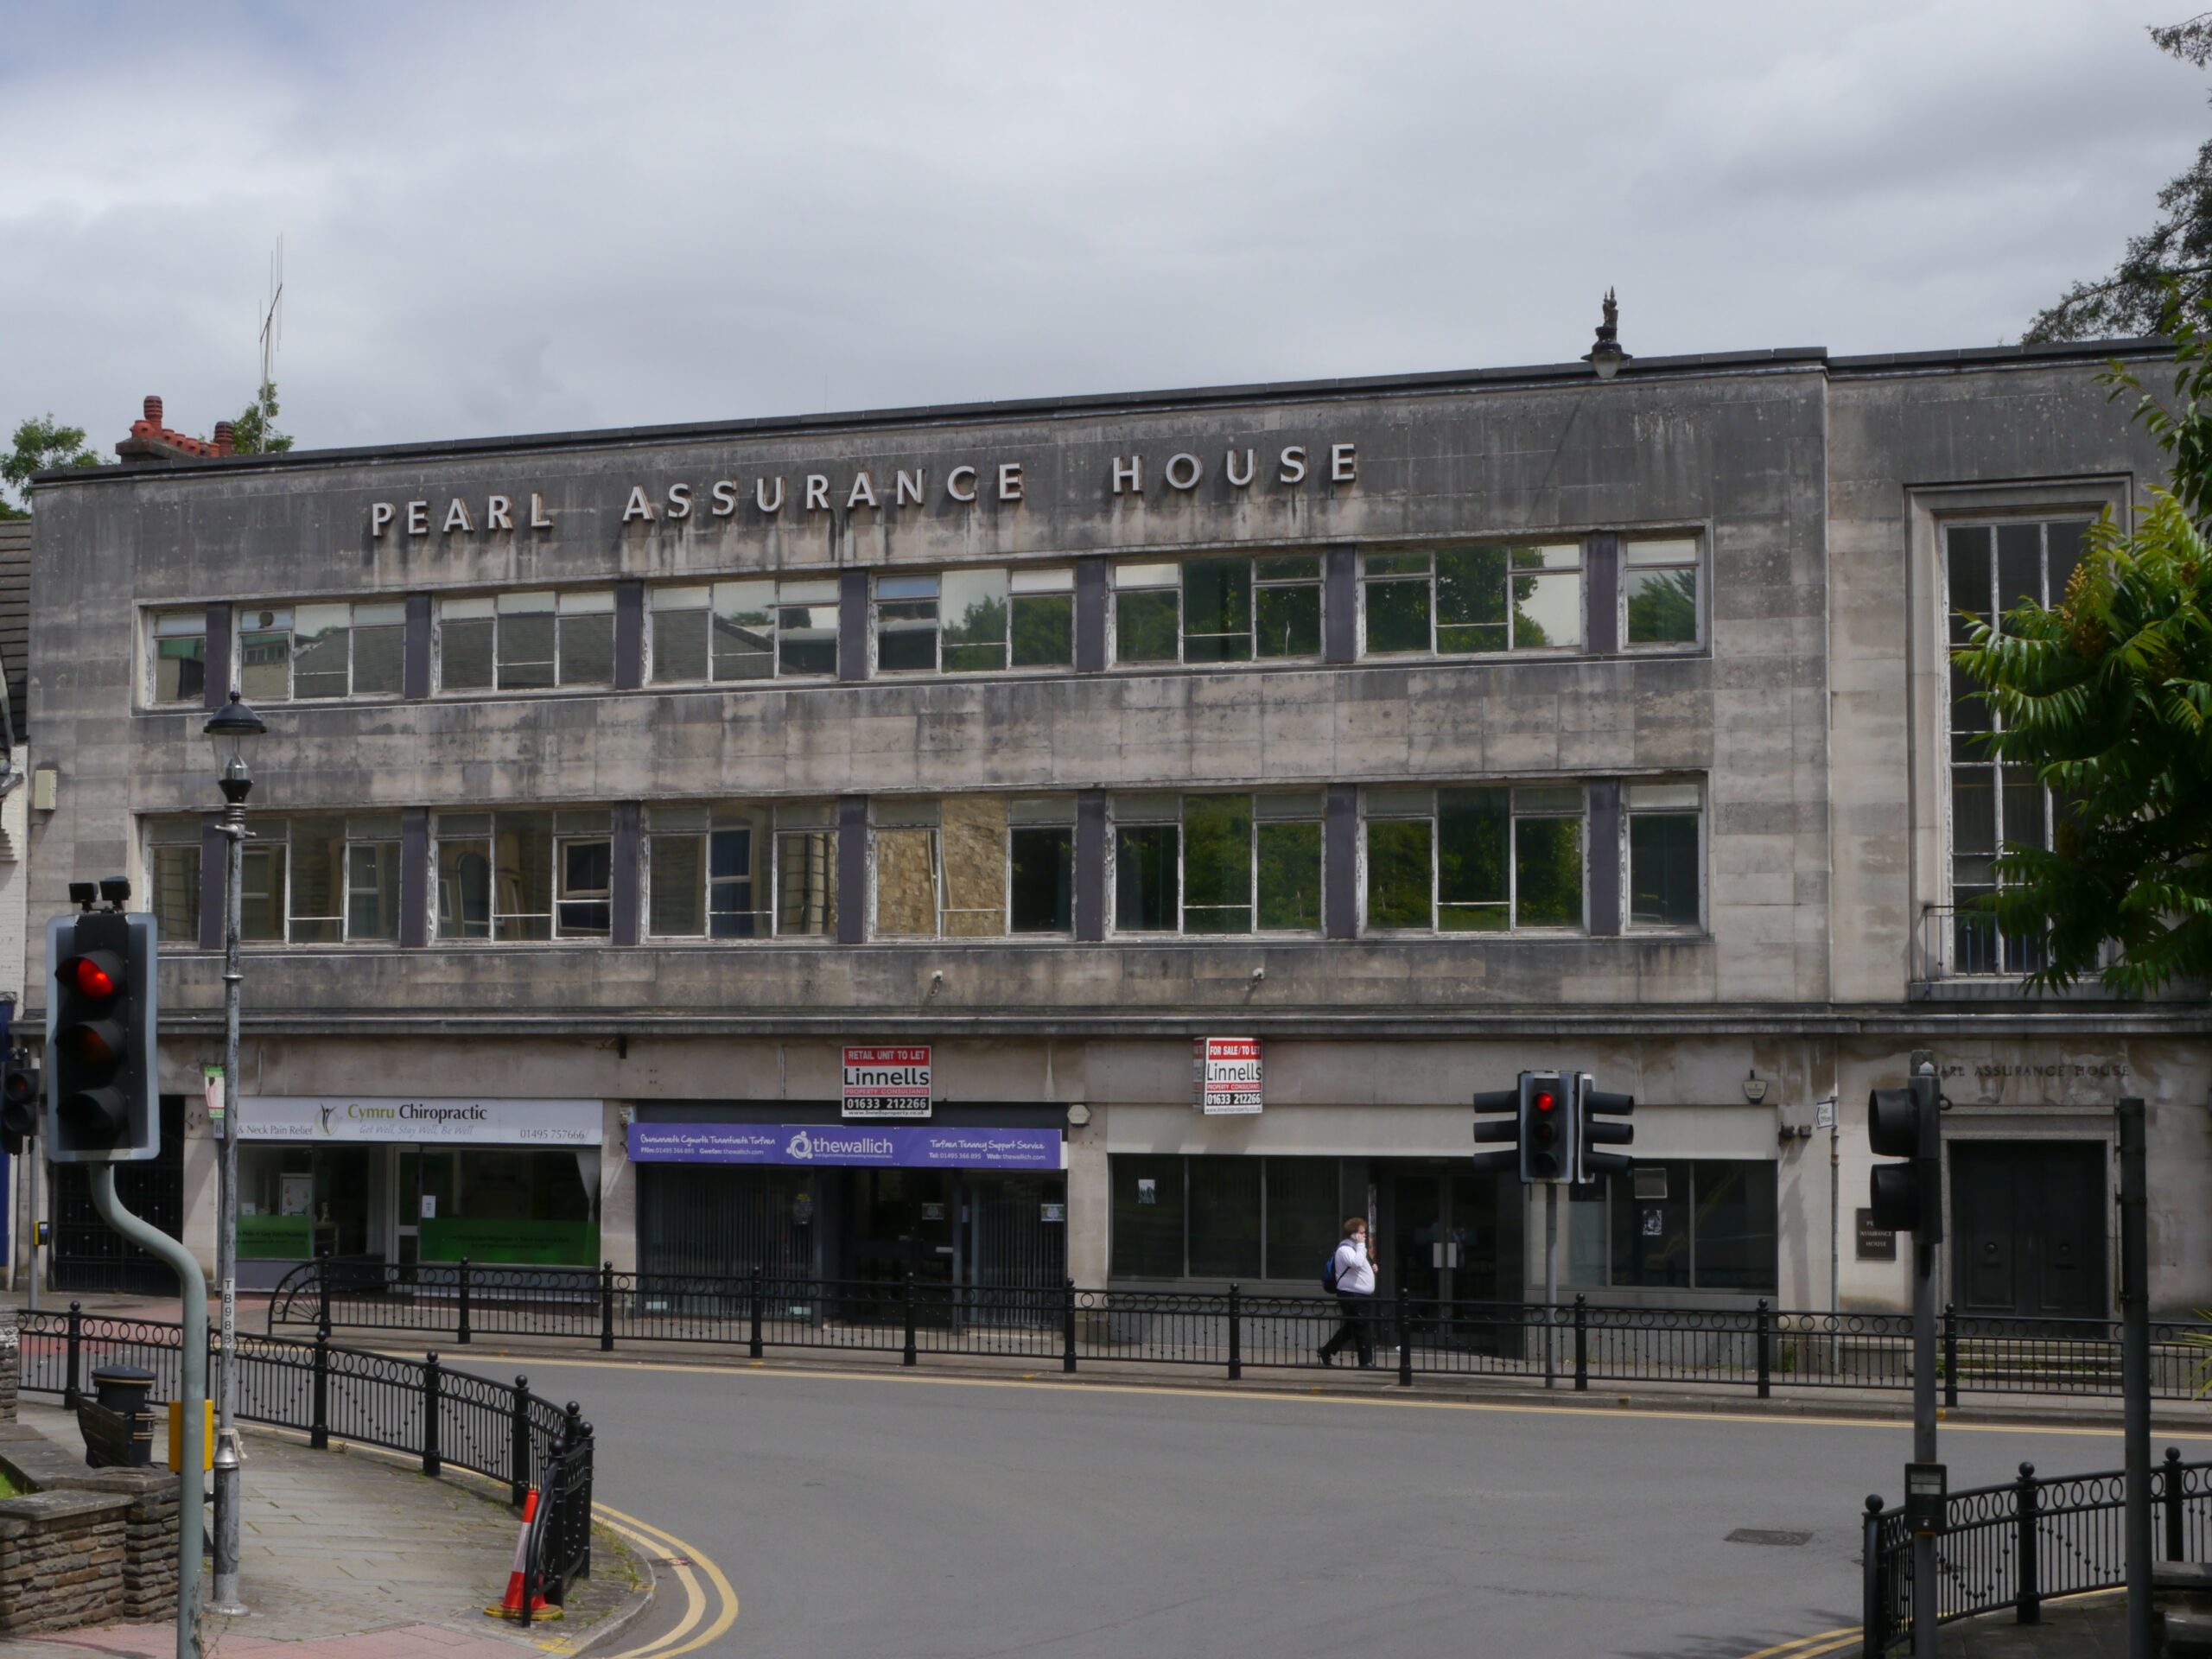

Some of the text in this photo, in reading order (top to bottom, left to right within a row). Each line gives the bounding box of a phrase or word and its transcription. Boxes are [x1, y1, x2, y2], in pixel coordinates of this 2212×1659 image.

[372, 443, 1357, 537] PEARL ASSURANCE HOUSE
[849, 1050, 925, 1059] RETAIL UNIT TO LET
[1210, 1046, 1222, 1056] FOR
[1250, 1046, 1261, 1055] LET
[843, 1067, 930, 1086] Linnells
[1207, 1063, 1262, 1081] Linnells
[1974, 1065, 2065, 1077] ASSURANCE
[2075, 1065, 2129, 1077] HOUSE
[847, 1098, 926, 1109] 01633 212266
[1207, 1093, 1261, 1104] 01633 212266
[347, 1103, 487, 1124] Cymru Chiropractic
[237, 1125, 313, 1135] & Neck Pain Relief
[359, 1125, 374, 1135] Get
[398, 1125, 416, 1137] Stay
[442, 1126, 452, 1135] Be
[454, 1125, 474, 1135] Well
[520, 1128, 585, 1140] 01495 757666
[812, 1137, 893, 1154] thewallich
[988, 1140, 1016, 1152] Support
[1017, 1141, 1045, 1149] Service
